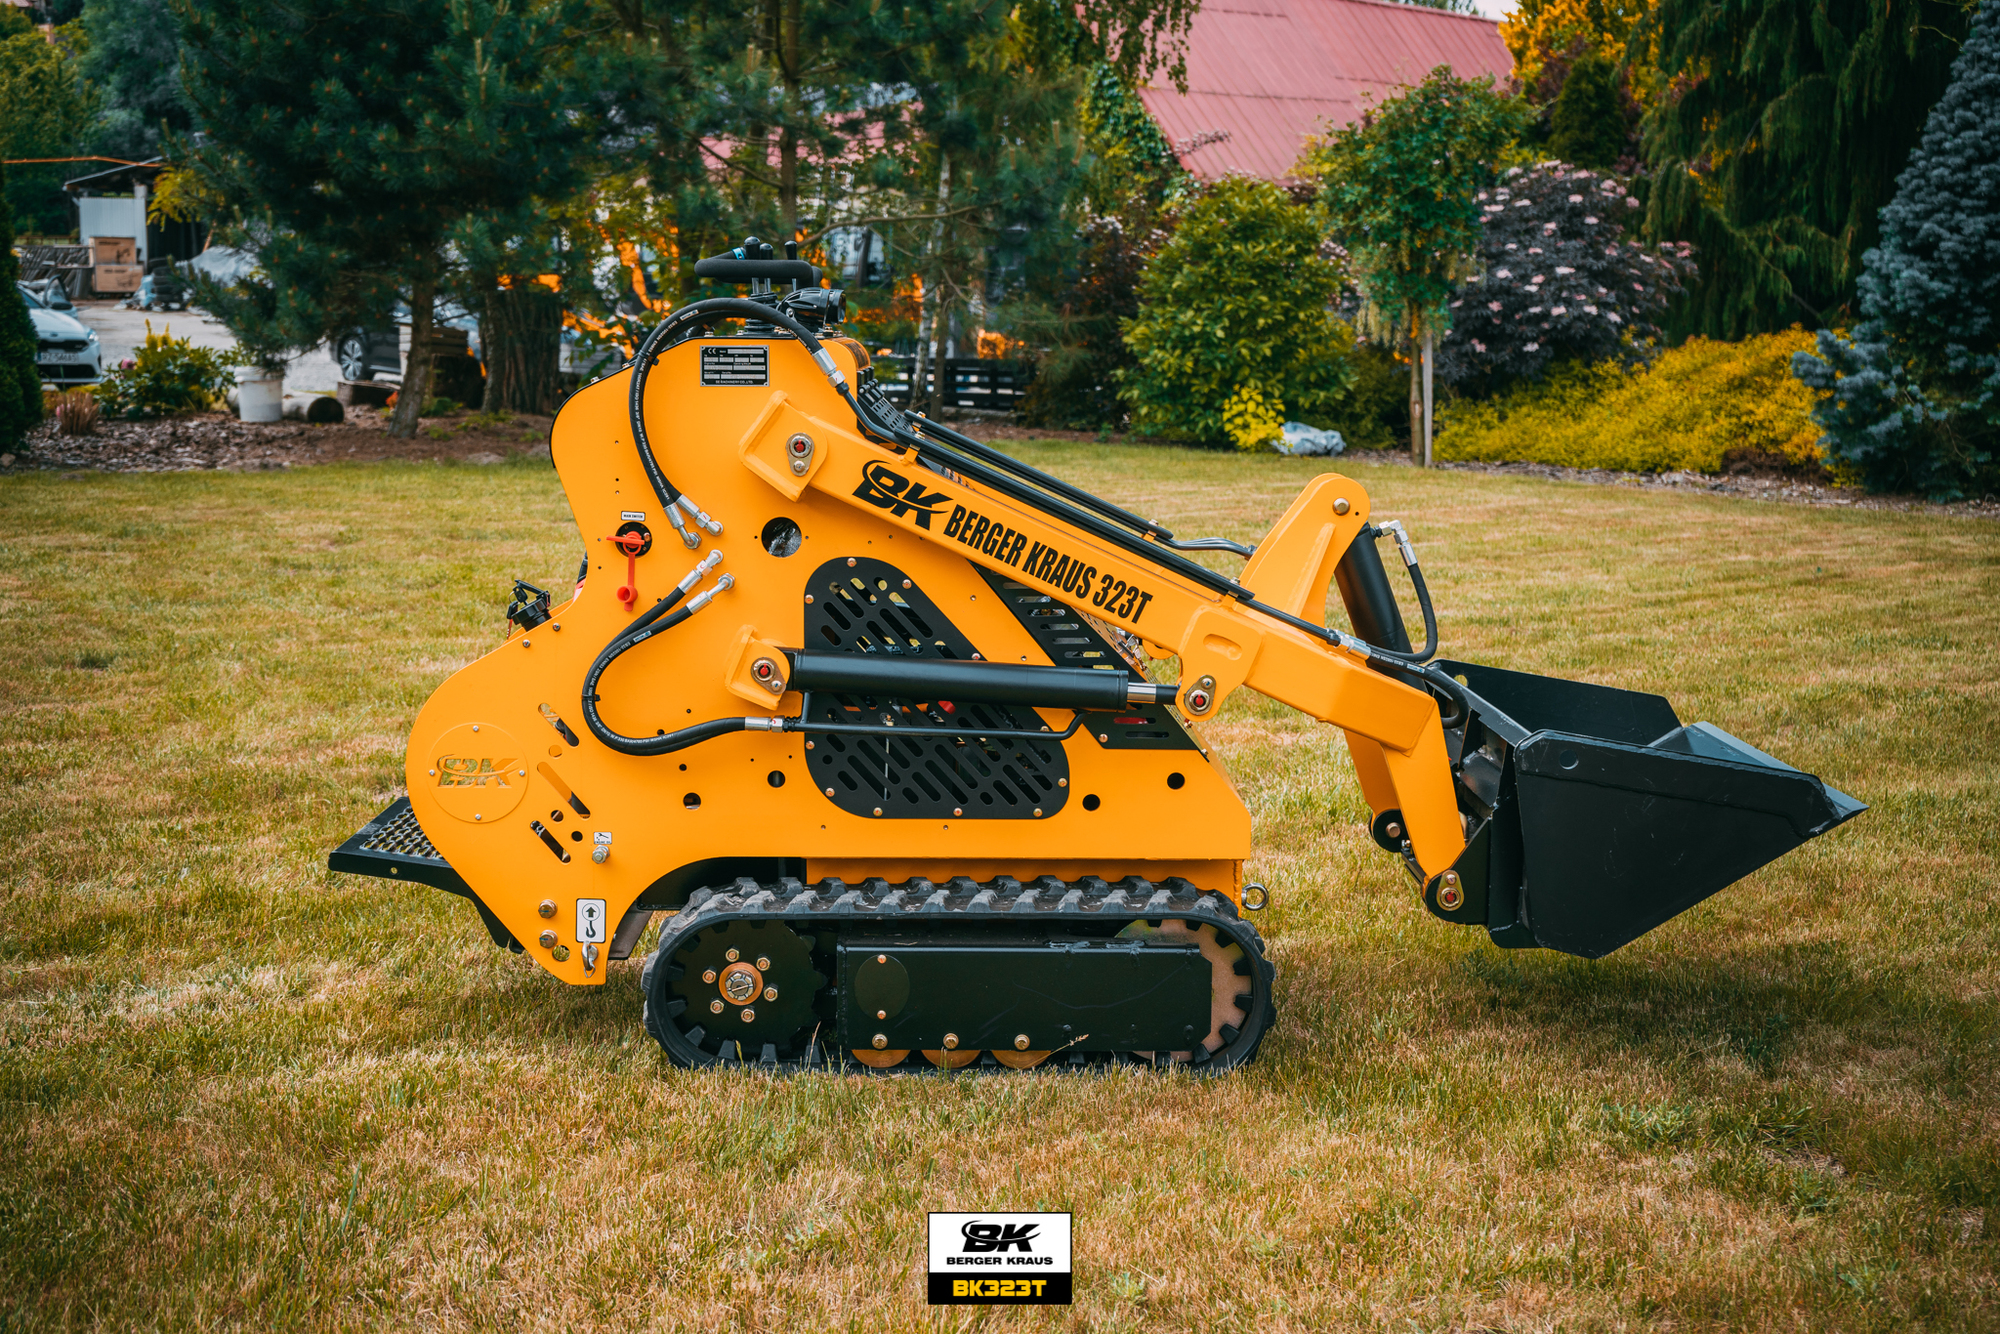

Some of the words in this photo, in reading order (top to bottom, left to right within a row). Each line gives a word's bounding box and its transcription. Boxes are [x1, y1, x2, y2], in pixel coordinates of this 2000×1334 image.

[852, 460, 954, 530] BK
[943, 504, 1028, 568] BERGER
[1022, 540, 1098, 599] KRAUS
[1092, 574, 1154, 624] 323T
